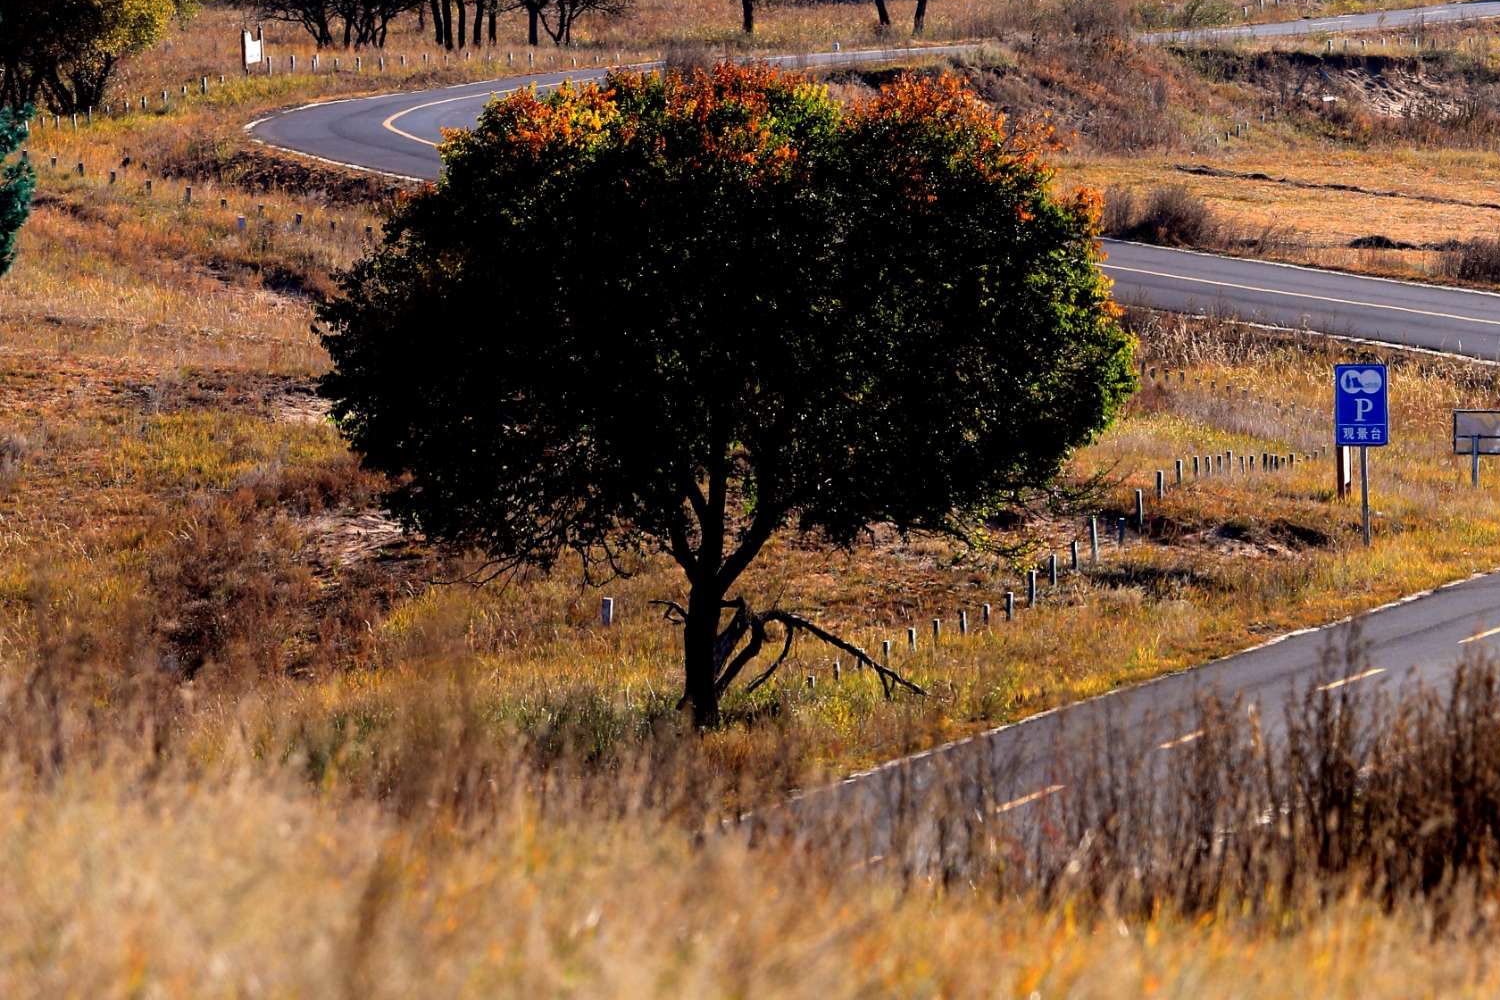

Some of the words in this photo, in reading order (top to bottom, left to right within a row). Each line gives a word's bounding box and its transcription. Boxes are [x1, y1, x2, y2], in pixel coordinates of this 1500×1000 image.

[1354, 398, 1373, 421] P
[1343, 427, 1381, 440] 观景台
